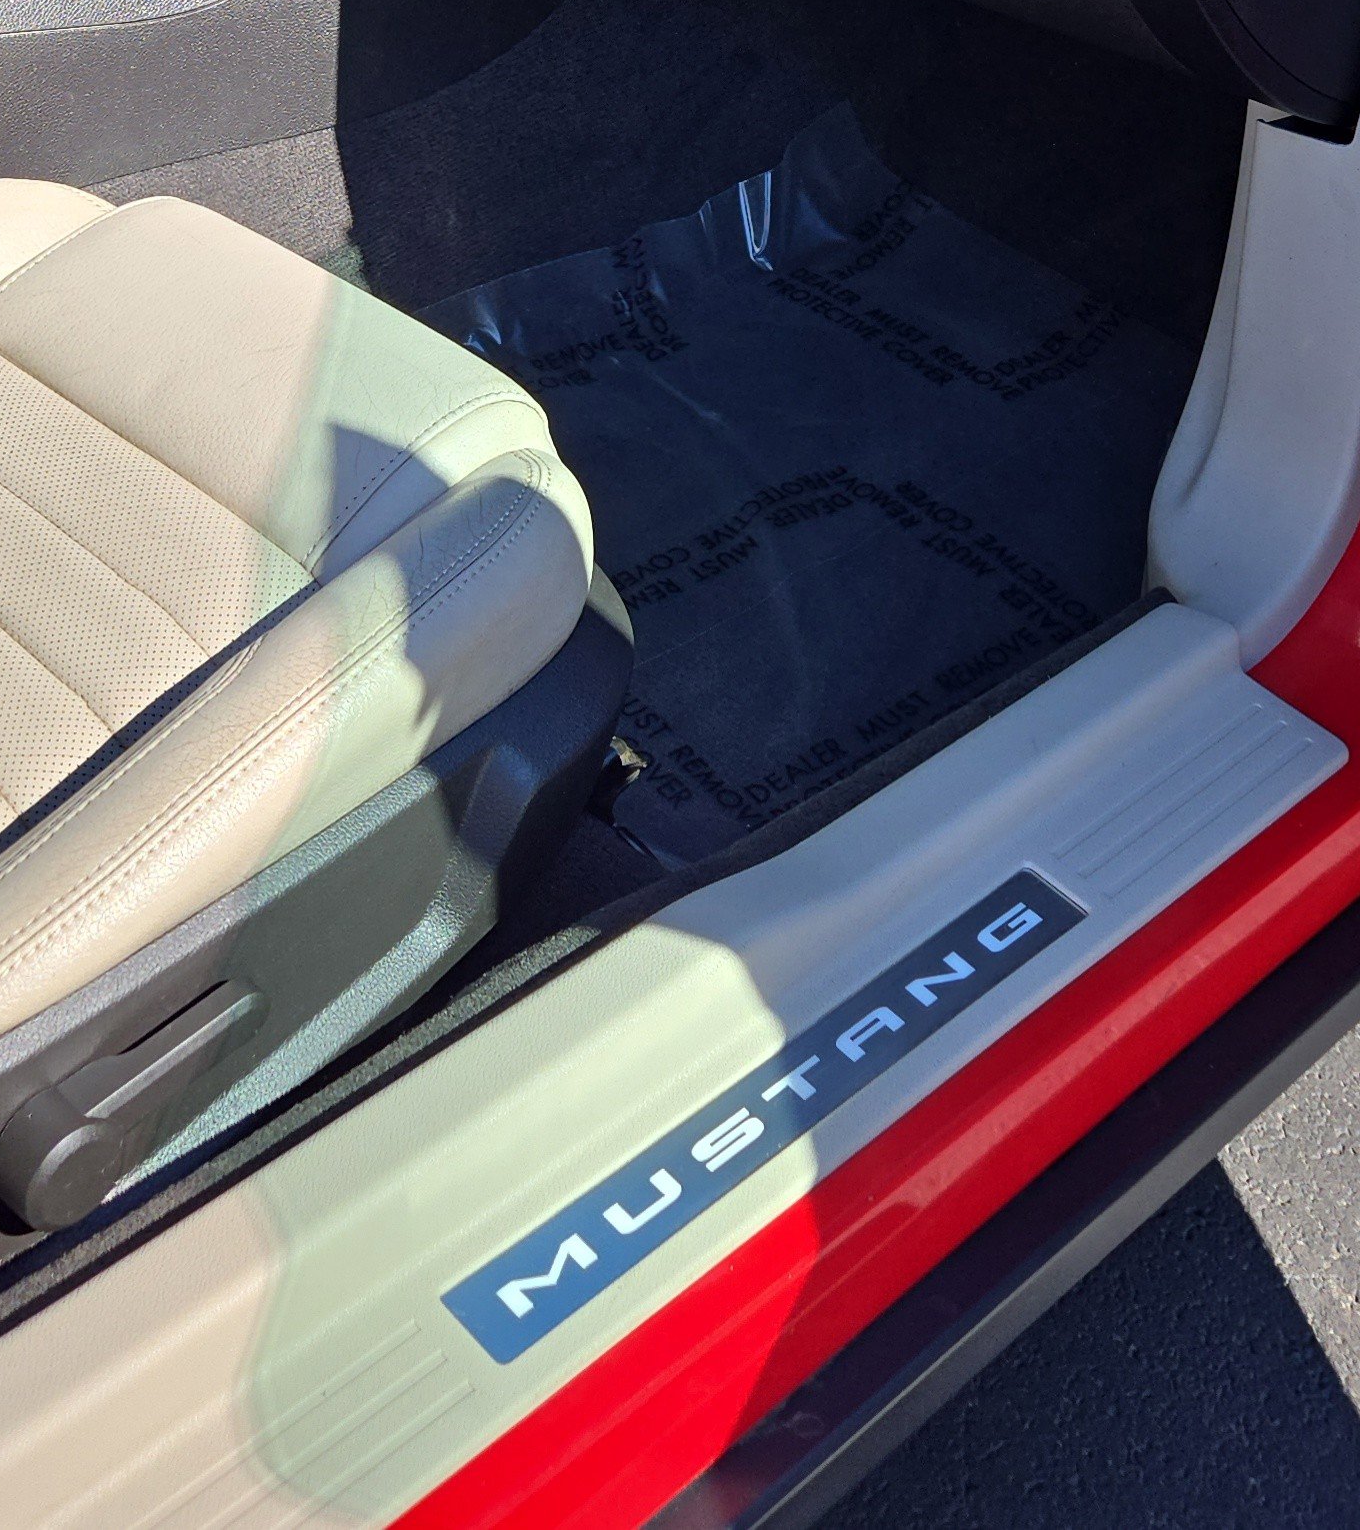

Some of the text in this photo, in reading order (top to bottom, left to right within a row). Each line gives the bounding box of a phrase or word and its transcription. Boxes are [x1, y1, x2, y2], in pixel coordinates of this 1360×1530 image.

[767, 277, 955, 387] PROTECTIVE COVER
[789, 267, 1026, 401] DEALER MUST REMOVE
[994, 330, 1072, 377] DEALER
[689, 535, 760, 583] MUST
[694, 471, 832, 551] PROTECTIVE
[764, 491, 854, 529] DEALER
[825, 464, 1074, 645] EALER MUST REMOVE
[895, 480, 974, 532] COVER
[621, 697, 673, 740] UST
[668, 743, 768, 832] REMOV
[744, 738, 849, 805] DEALER
[855, 689, 931, 744] MUST
[934, 626, 1042, 692] REMOVE
[495, 901, 1044, 1319] MUSTANG
